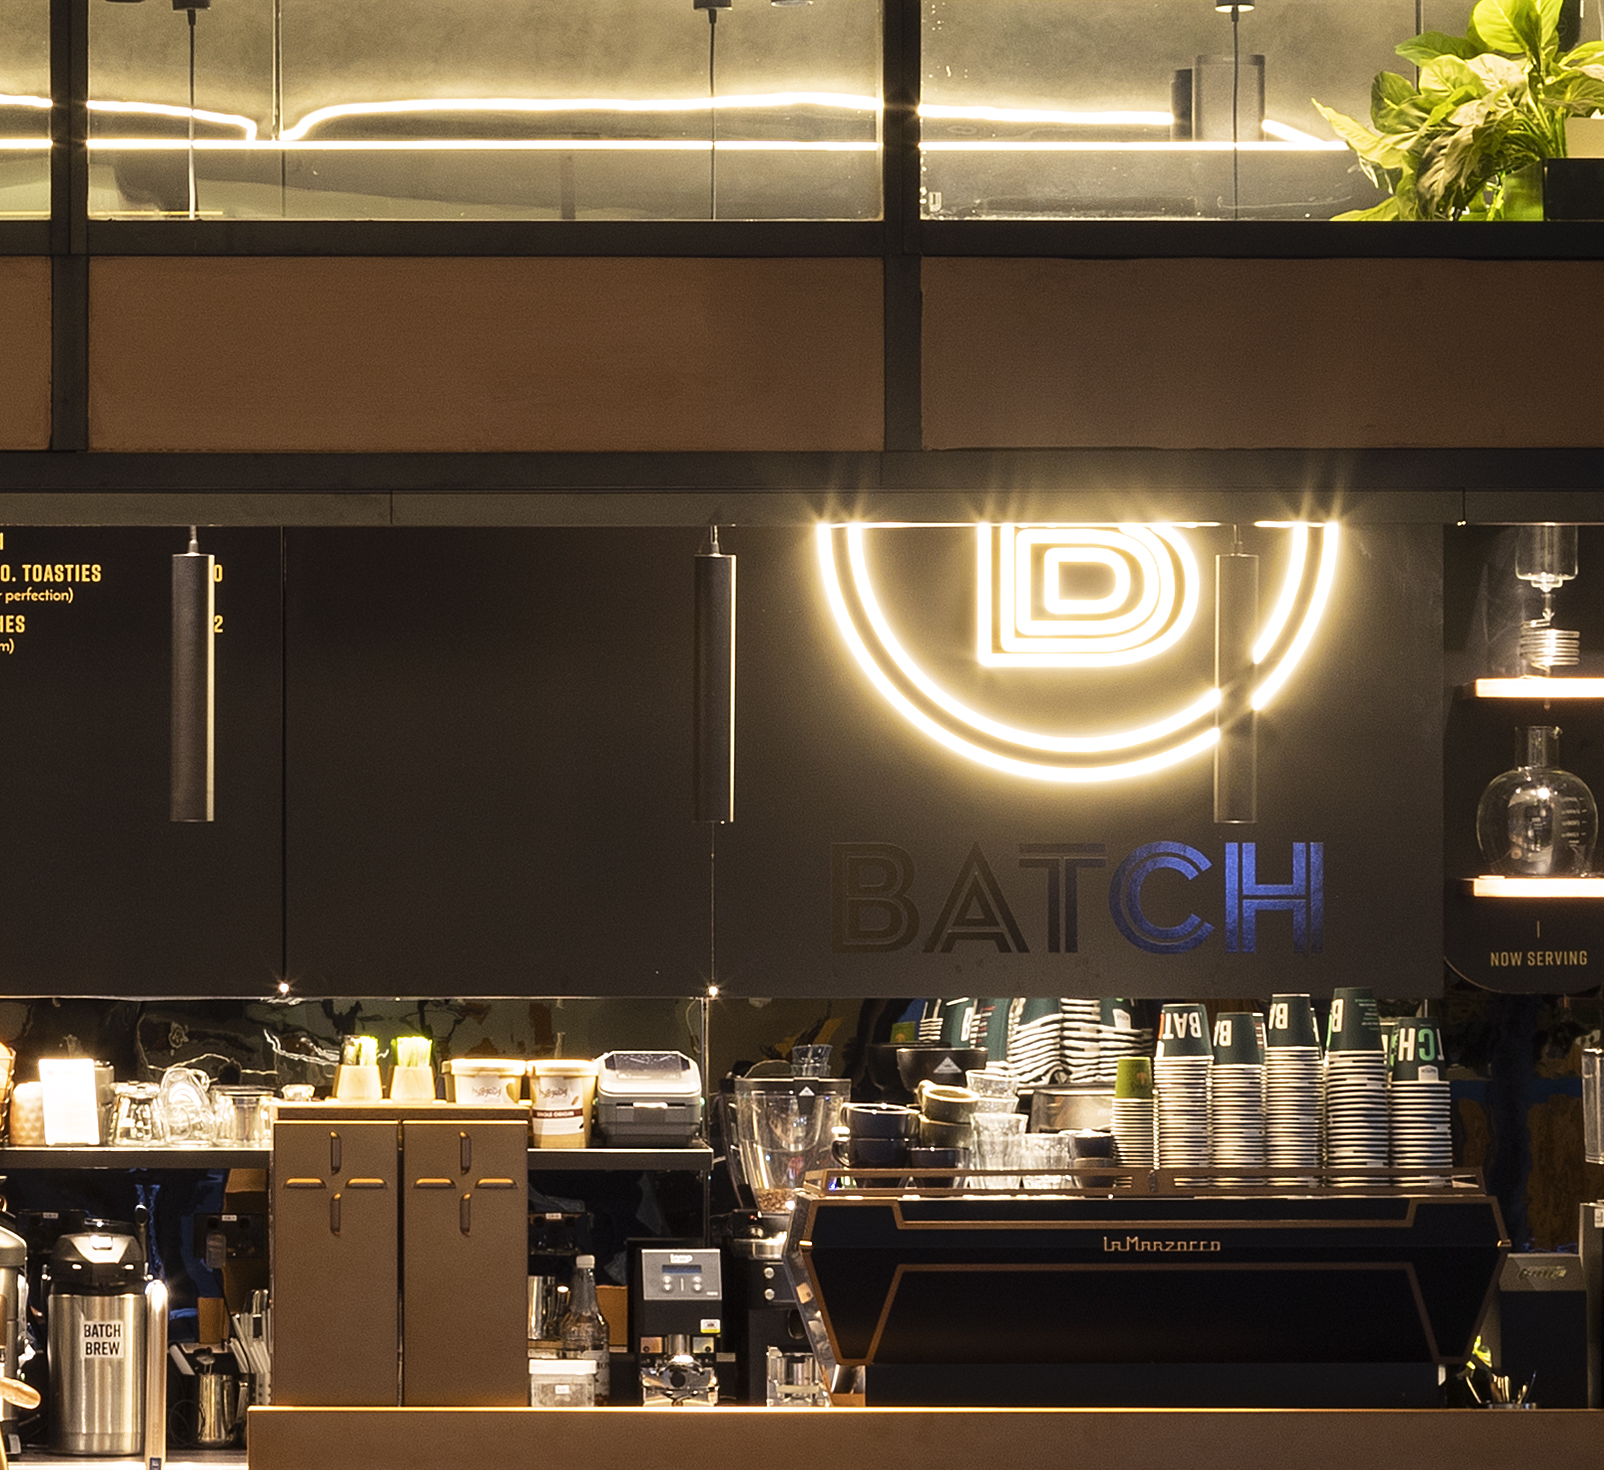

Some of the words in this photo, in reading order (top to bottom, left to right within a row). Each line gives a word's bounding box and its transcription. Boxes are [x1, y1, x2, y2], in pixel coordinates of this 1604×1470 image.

[22, 564, 101, 582] TOASTIES
[5, 587, 73, 603] perfection)
[830, 841, 1325, 955] BATCH
[1491, 952, 1523, 967] NOW
[1528, 951, 1588, 966] SERVING
[84, 1323, 121, 1339] BATCH
[85, 1341, 120, 1356] BREW
